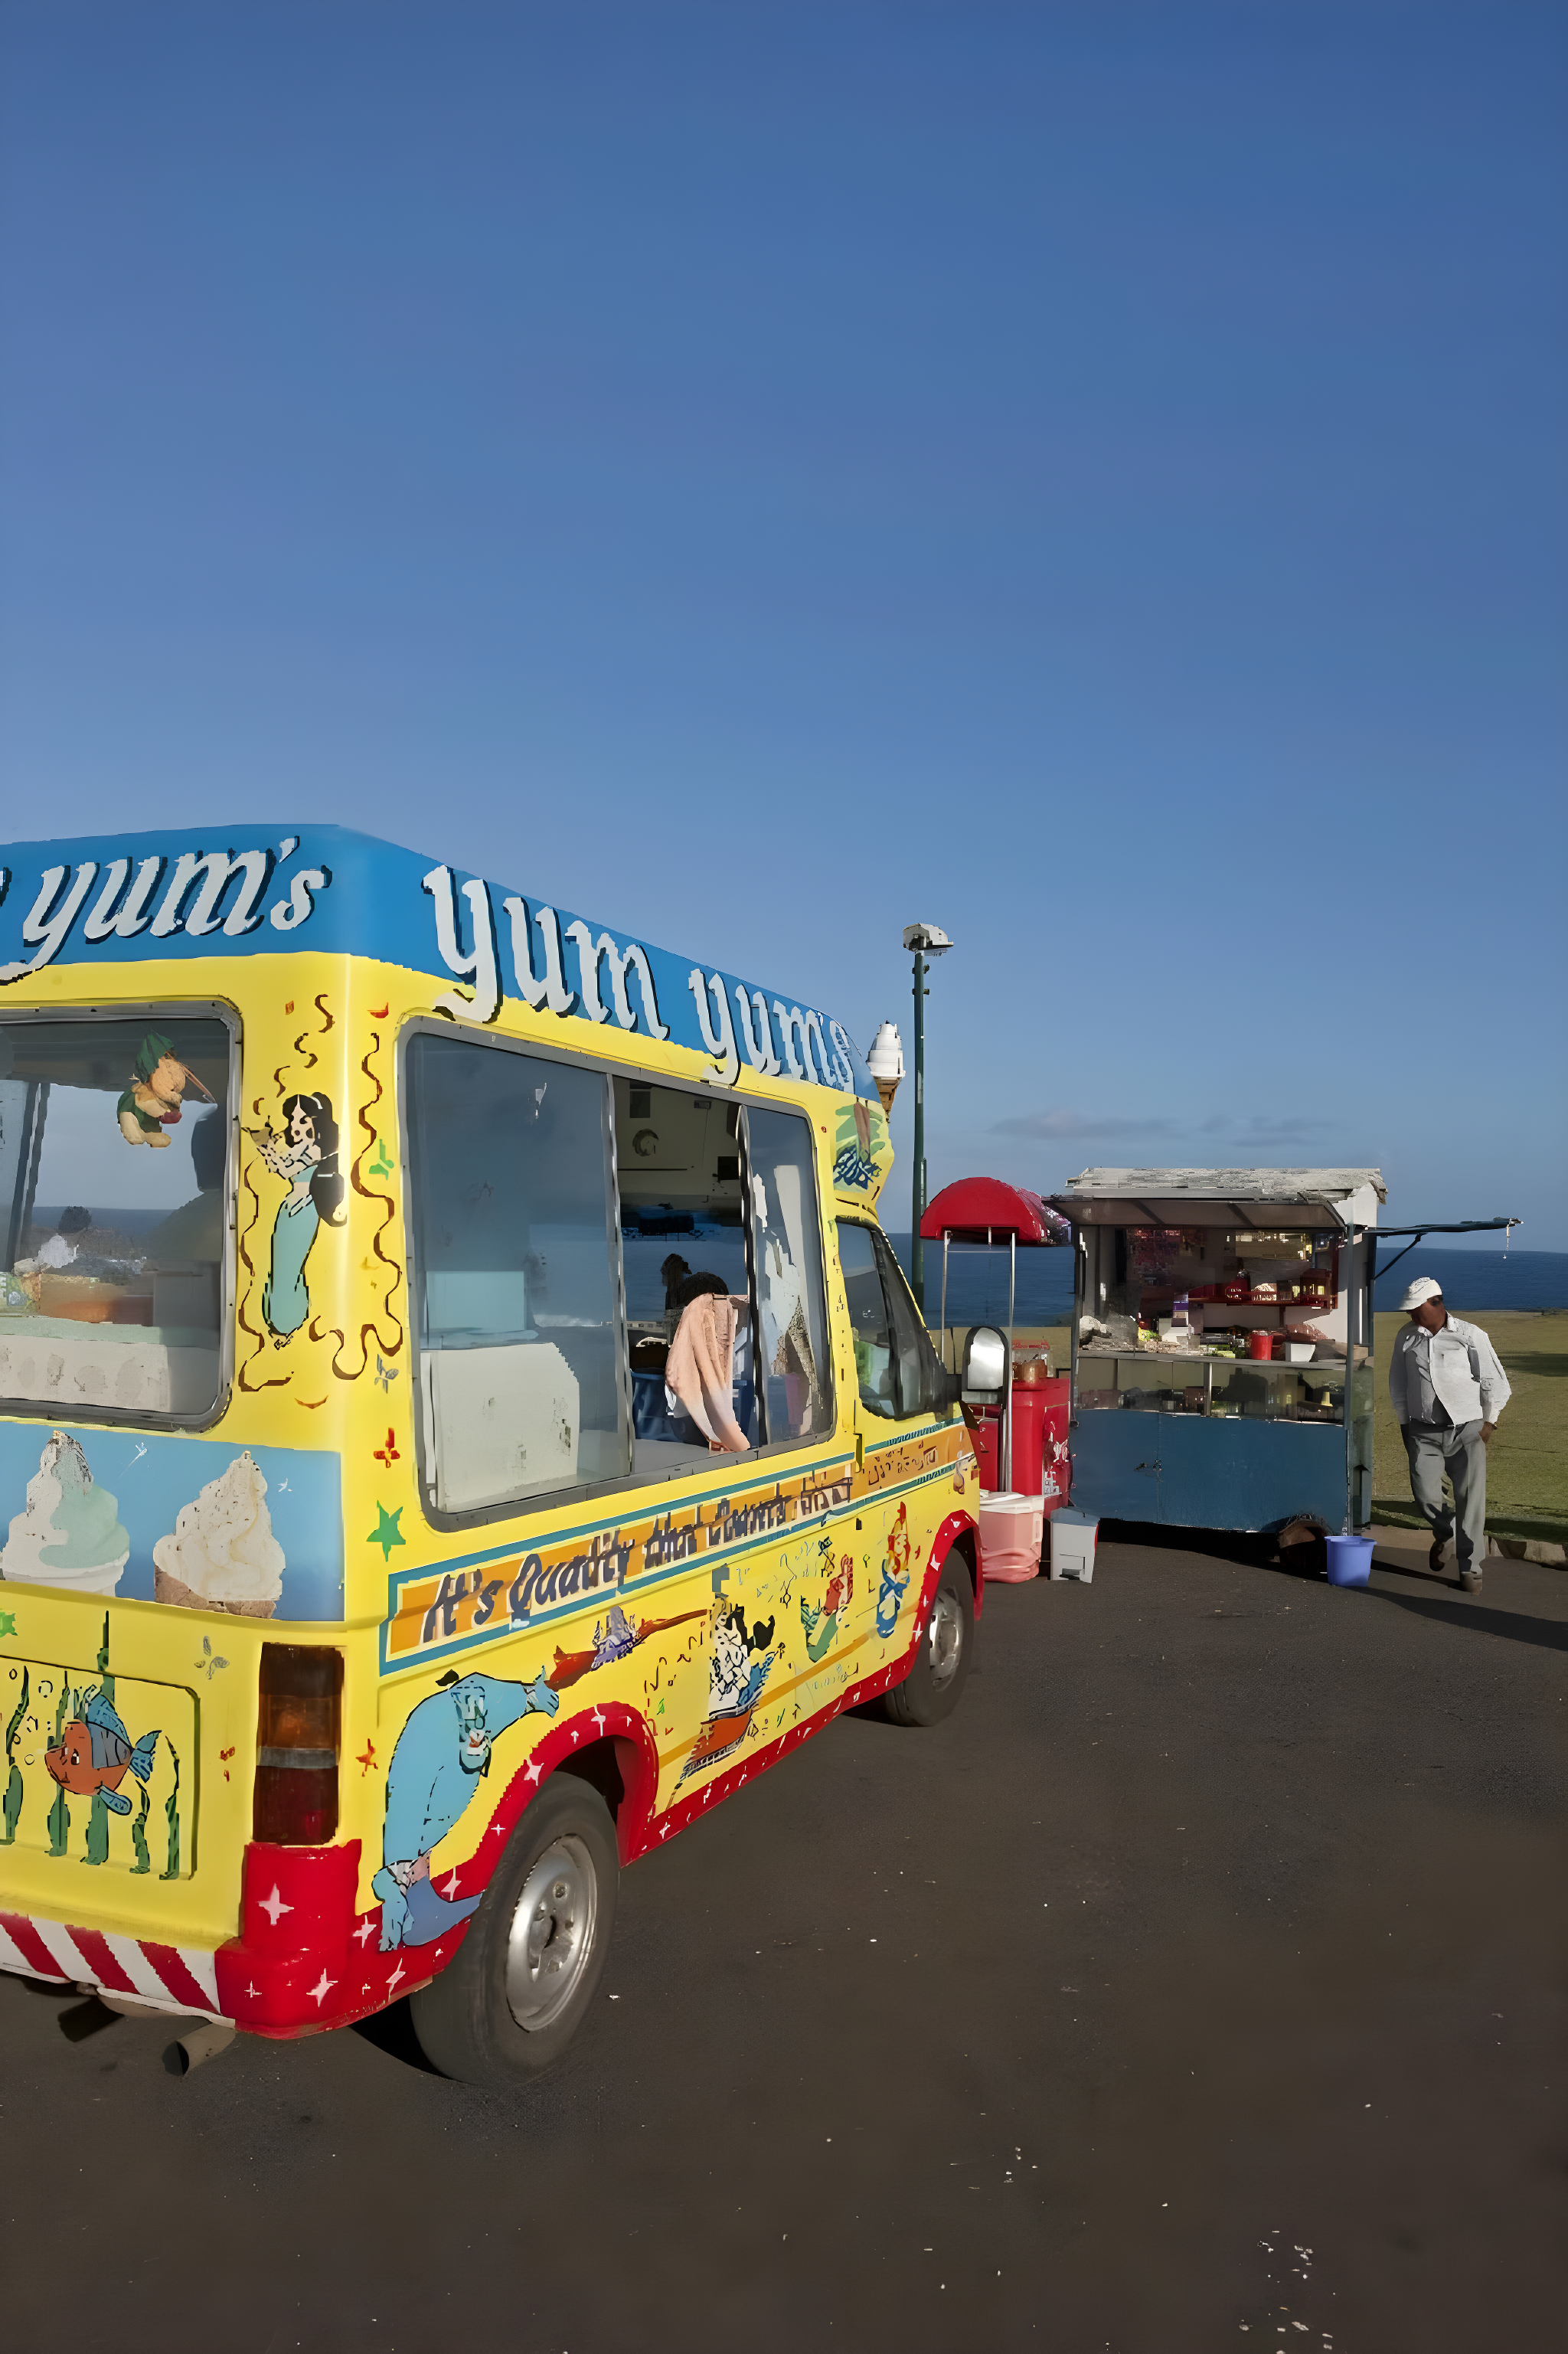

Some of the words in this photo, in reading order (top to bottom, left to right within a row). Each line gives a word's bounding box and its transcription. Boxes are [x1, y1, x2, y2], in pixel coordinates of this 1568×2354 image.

[0, 835, 332, 985] yum's
[421, 864, 670, 1040] yum
[688, 968, 854, 1095] yum's
[420, 1569, 504, 1644] It's
